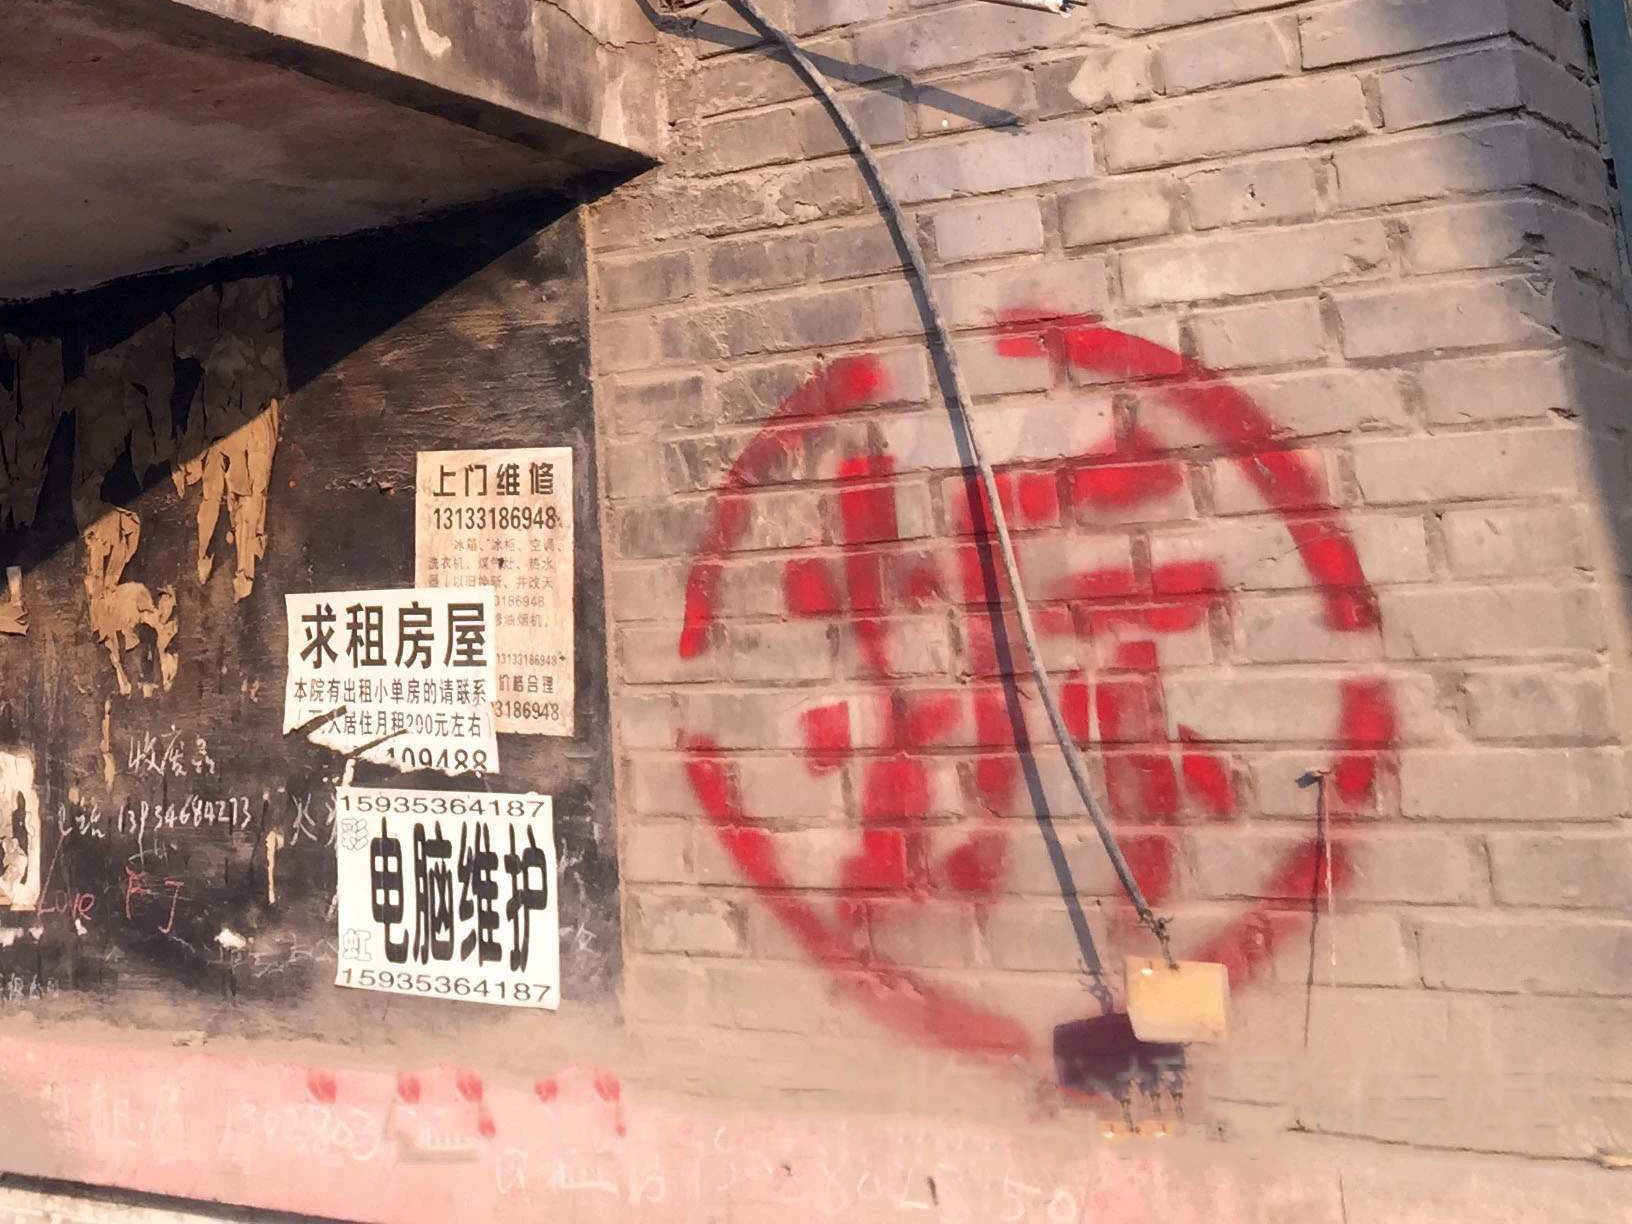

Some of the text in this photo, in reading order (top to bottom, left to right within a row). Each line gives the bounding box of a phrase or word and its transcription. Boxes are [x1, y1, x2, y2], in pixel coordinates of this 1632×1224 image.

[433, 462, 554, 497] 上门维修
[433, 506, 557, 530] 13133186948
[300, 601, 487, 669] 求租房屋
[294, 678, 486, 706] 本院有出租小单房的请联系
[492, 700, 560, 721] 3186948
[340, 795, 545, 817] 15935364187
[369, 816, 549, 974] 电脑维护
[342, 968, 552, 1003] 15935364187
